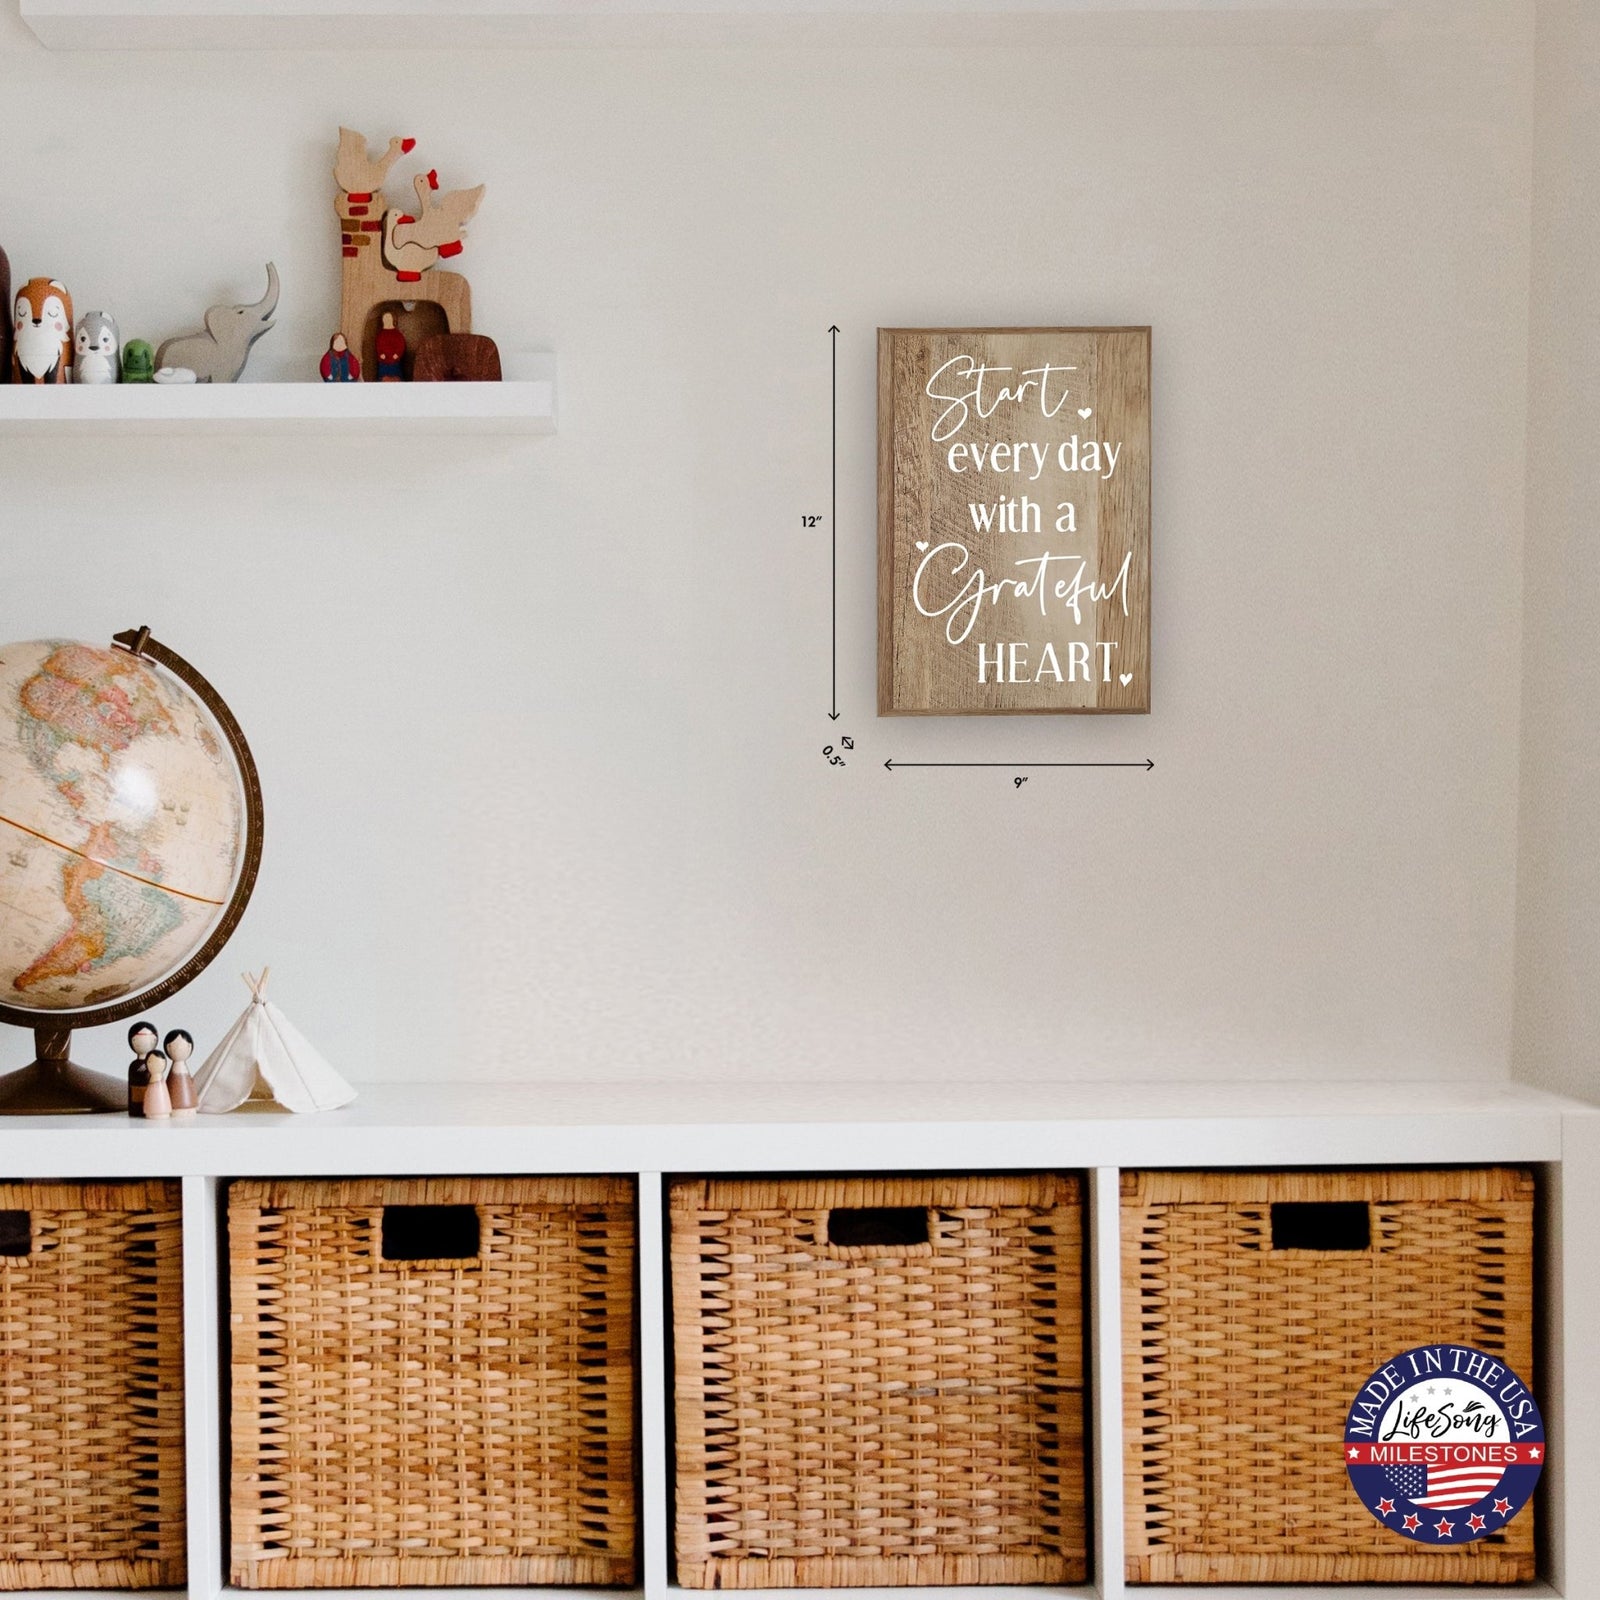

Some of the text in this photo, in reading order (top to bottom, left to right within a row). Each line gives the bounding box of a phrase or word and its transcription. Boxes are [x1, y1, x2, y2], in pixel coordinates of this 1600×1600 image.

[925, 355, 1077, 442] Start
[947, 434, 1122, 480] every day
[968, 494, 1077, 533] with a
[912, 542, 1132, 645] Grateful
[977, 642, 1118, 684] HEART
